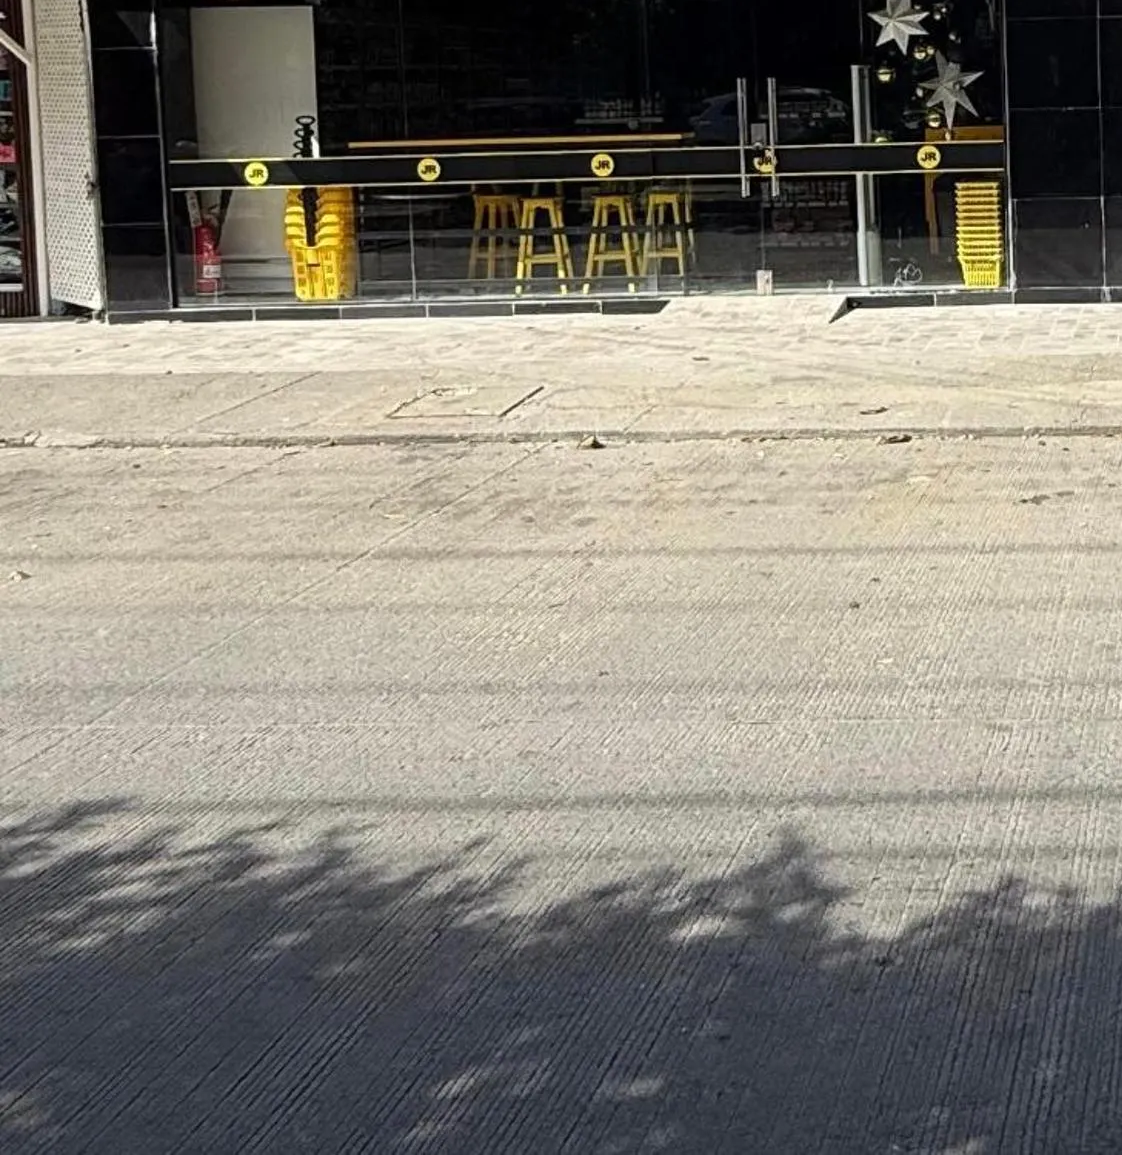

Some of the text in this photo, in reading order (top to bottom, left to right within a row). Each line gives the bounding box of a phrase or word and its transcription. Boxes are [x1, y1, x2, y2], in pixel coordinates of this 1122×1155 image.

[921, 151, 937, 162] JR
[421, 165, 437, 174] JR
[595, 160, 610, 170] JR
[249, 169, 264, 178] JR
